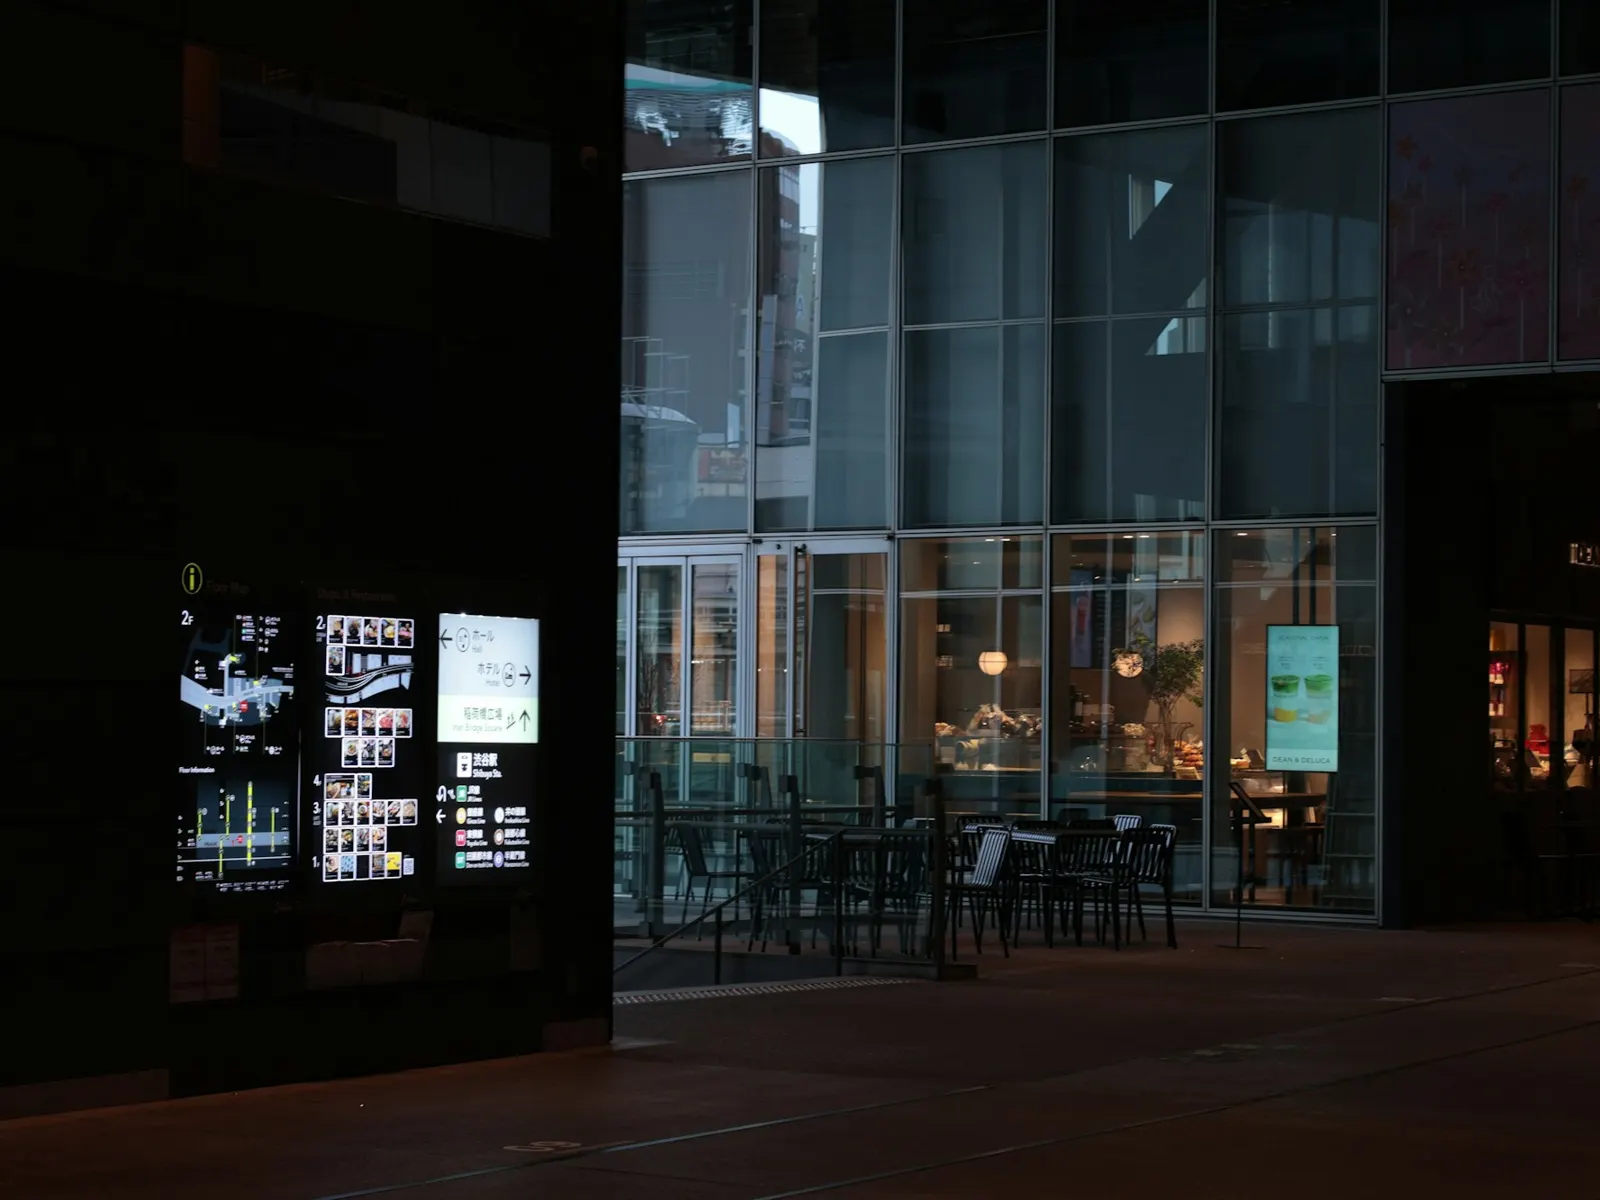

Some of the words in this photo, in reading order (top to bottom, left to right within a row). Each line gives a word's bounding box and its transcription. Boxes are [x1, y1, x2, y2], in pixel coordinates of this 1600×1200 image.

[181, 609, 194, 626] 2F
[472, 628, 495, 643] ホール
[477, 661, 501, 676] ホテル
[473, 752, 498, 767] 渋谷駅
[1272, 756, 1293, 764] DEAN
[1301, 757, 1331, 765] DELUCA
